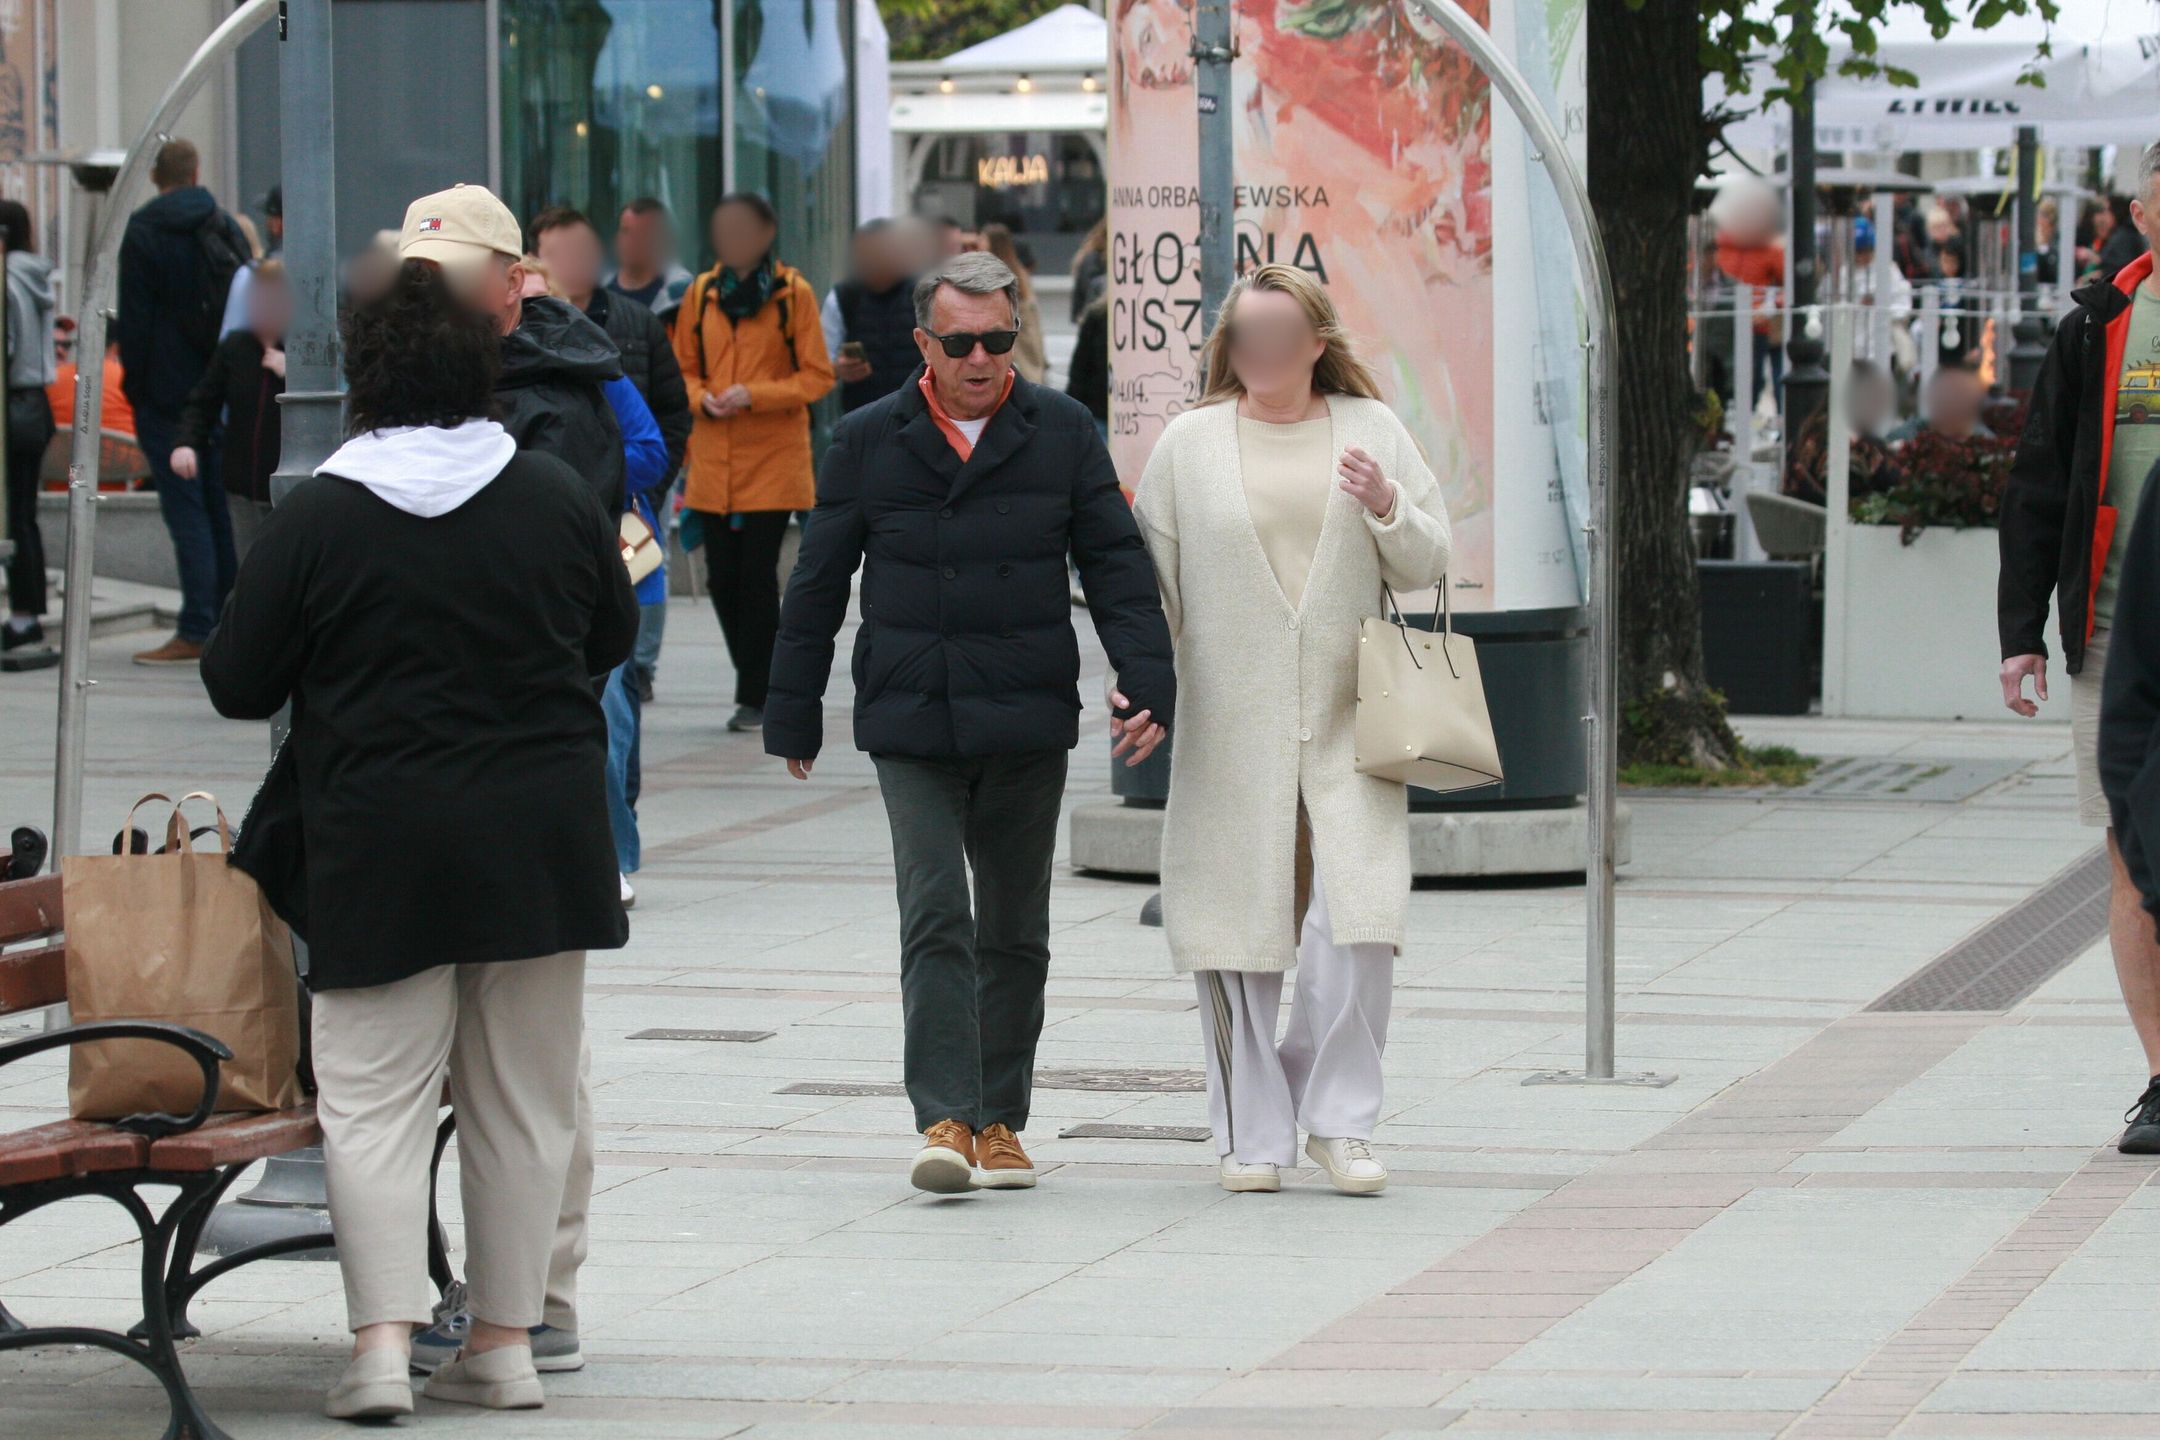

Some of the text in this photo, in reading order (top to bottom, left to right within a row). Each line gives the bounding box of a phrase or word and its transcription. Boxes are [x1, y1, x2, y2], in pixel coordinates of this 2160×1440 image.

[1112, 186, 1330, 208] ANNA ORBAEWSKA
[1112, 231, 1330, 286] GŁONA
